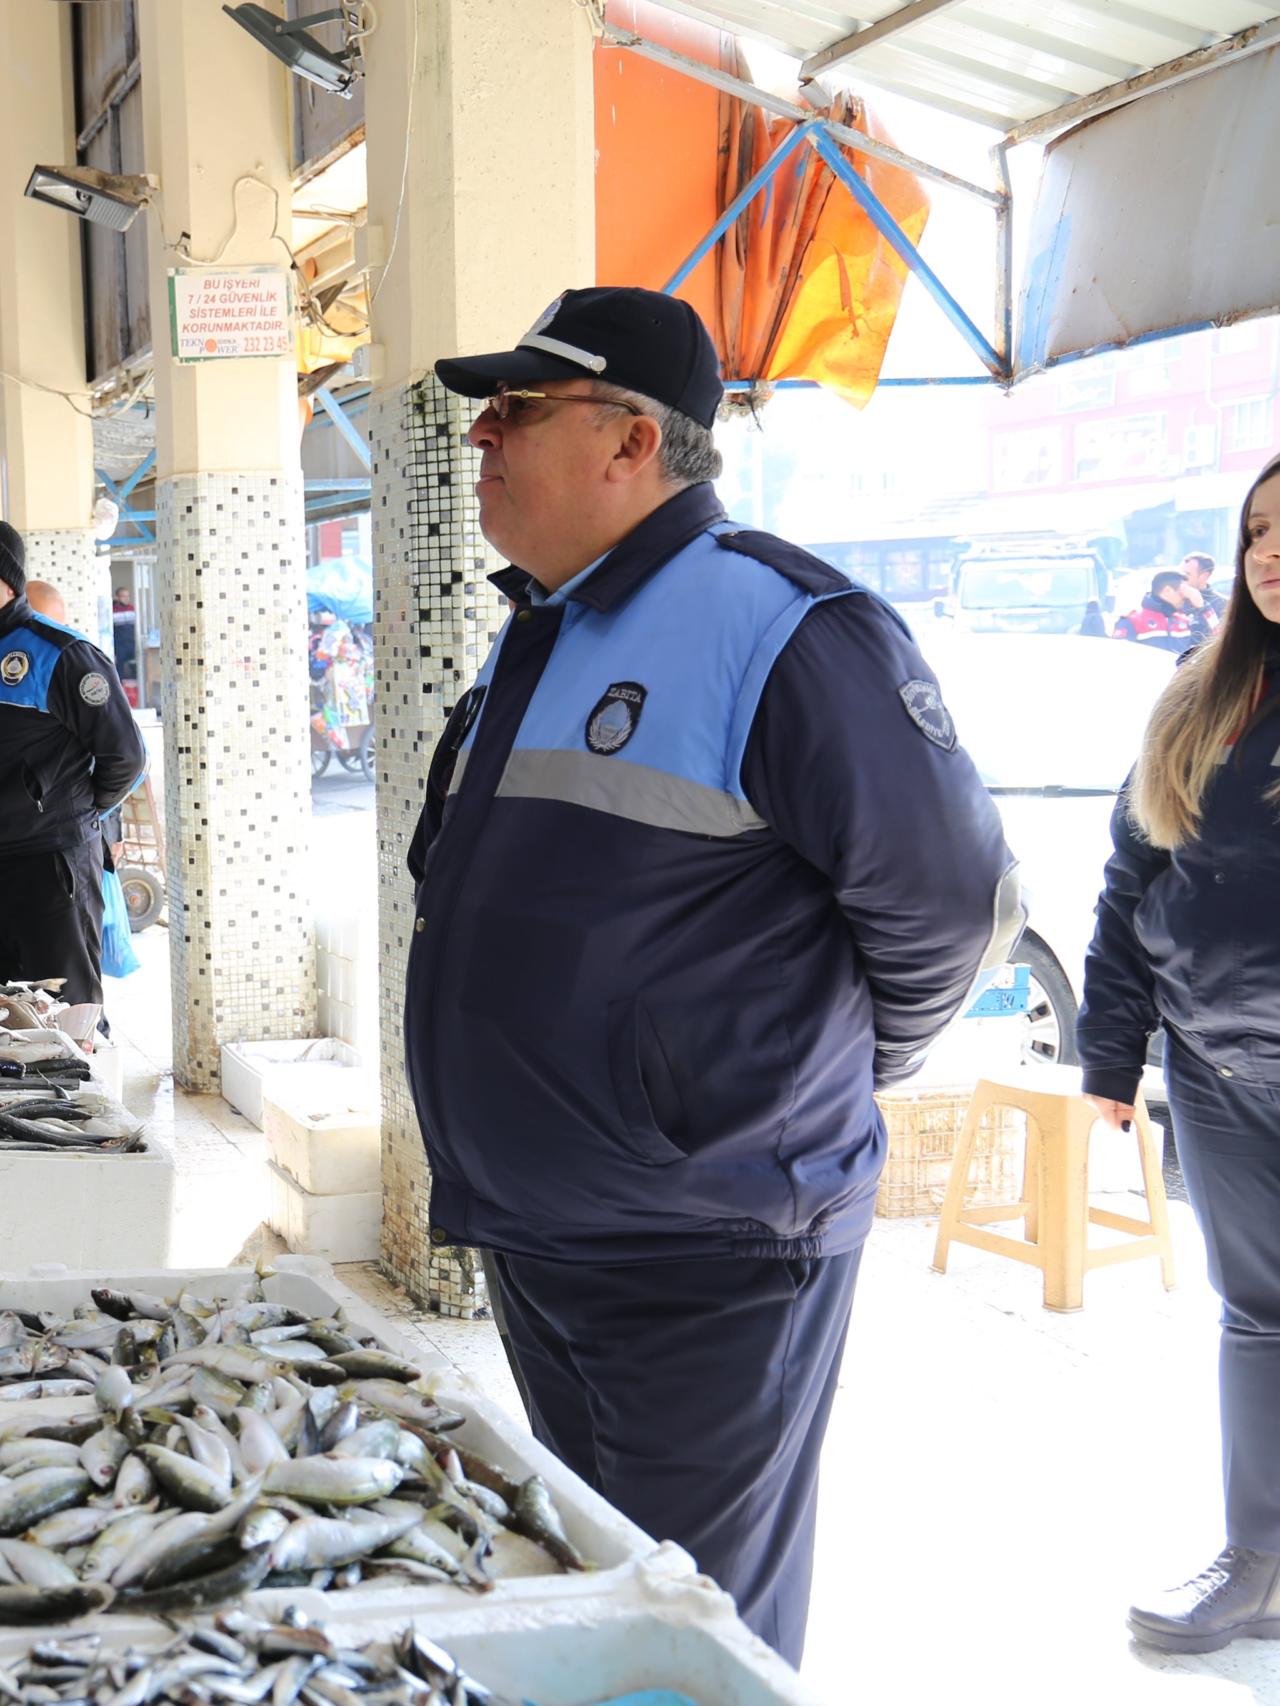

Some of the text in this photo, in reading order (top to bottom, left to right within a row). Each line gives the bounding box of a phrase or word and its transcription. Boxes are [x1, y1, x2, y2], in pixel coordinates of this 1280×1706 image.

[203, 279, 221, 290] BU
[188, 294, 194, 305] 7
[204, 294, 216, 305] 24
[219, 290, 277, 304] GÜVENLİK
[189, 305, 277, 319] SİSTEMLERİ İLE
[607, 687, 641, 703] ZABITA
